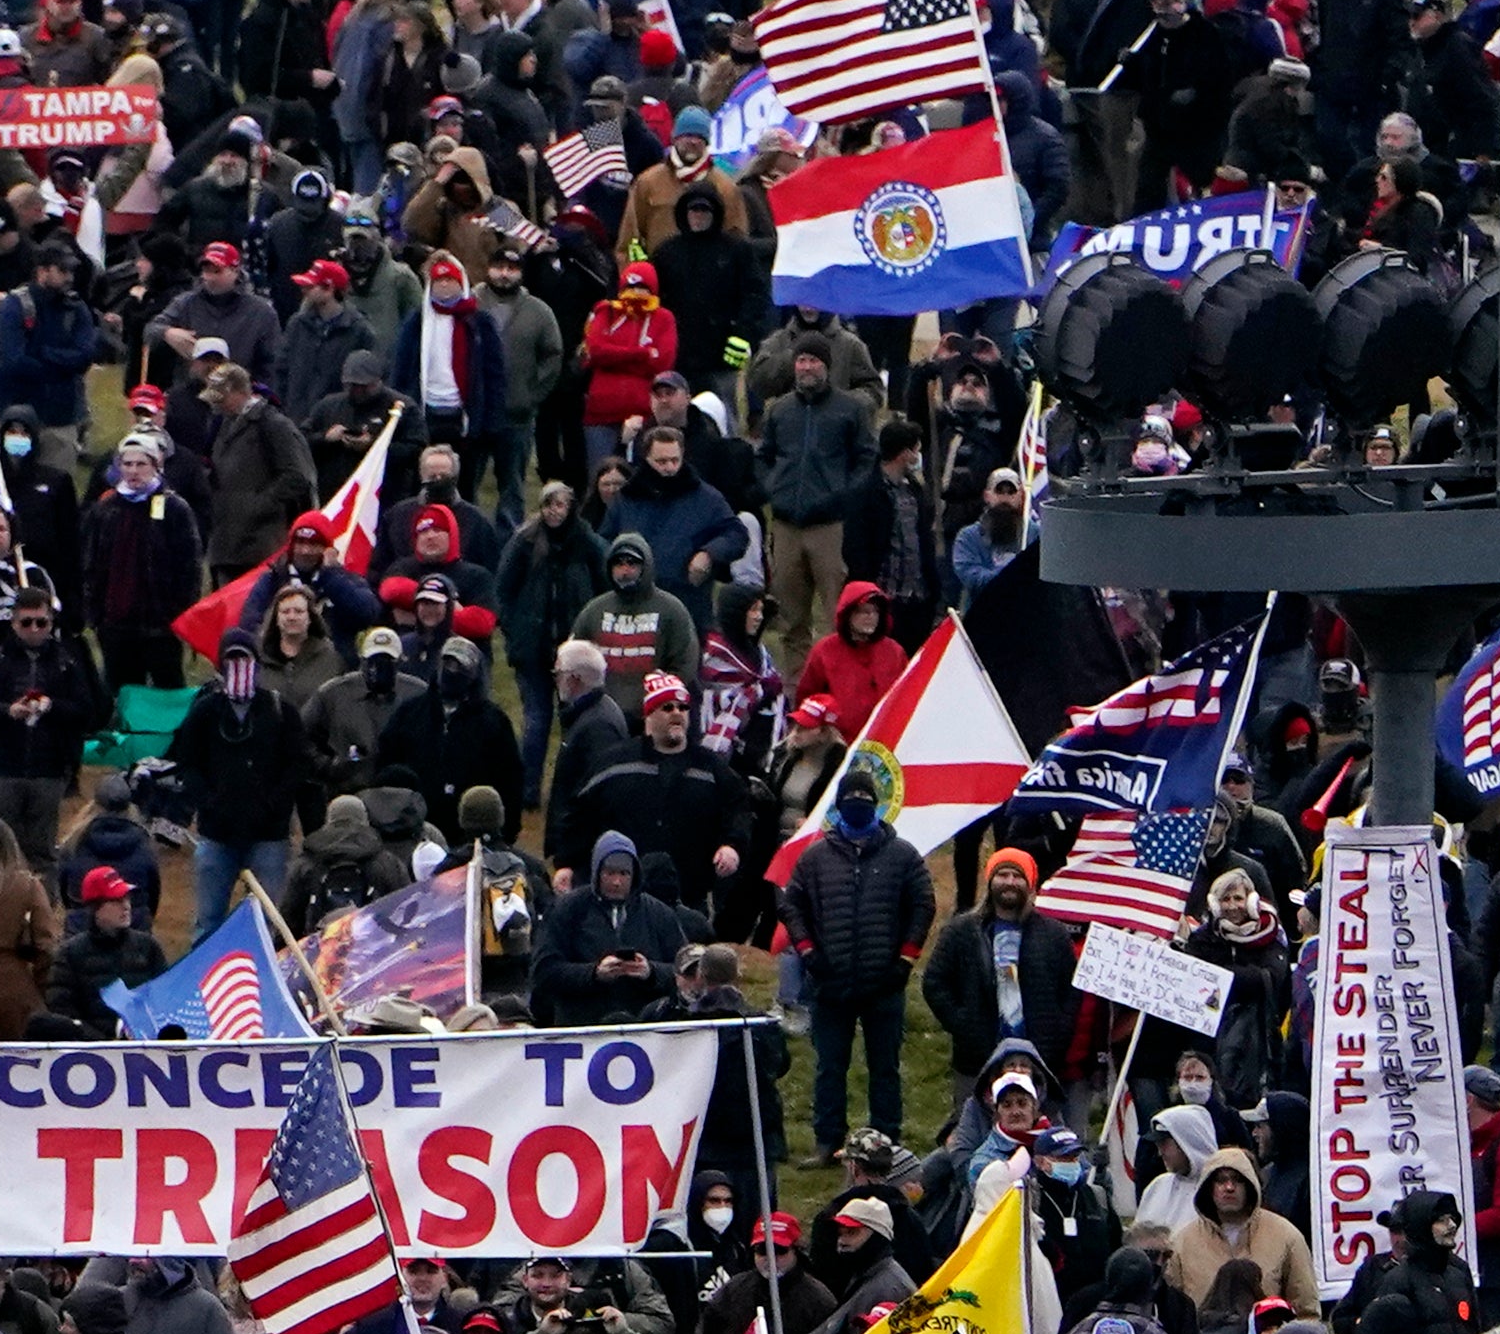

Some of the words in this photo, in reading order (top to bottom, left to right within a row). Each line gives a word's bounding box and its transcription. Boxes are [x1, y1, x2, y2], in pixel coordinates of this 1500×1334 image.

[22, 90, 132, 118] TAMPA
[1333, 855, 1368, 1016] STEAL
[524, 1041, 656, 1108] TO
[1329, 1035, 1364, 1113] THE
[1374, 972, 1419, 1159] SURRENDER
[1329, 1129, 1371, 1265] STOP
